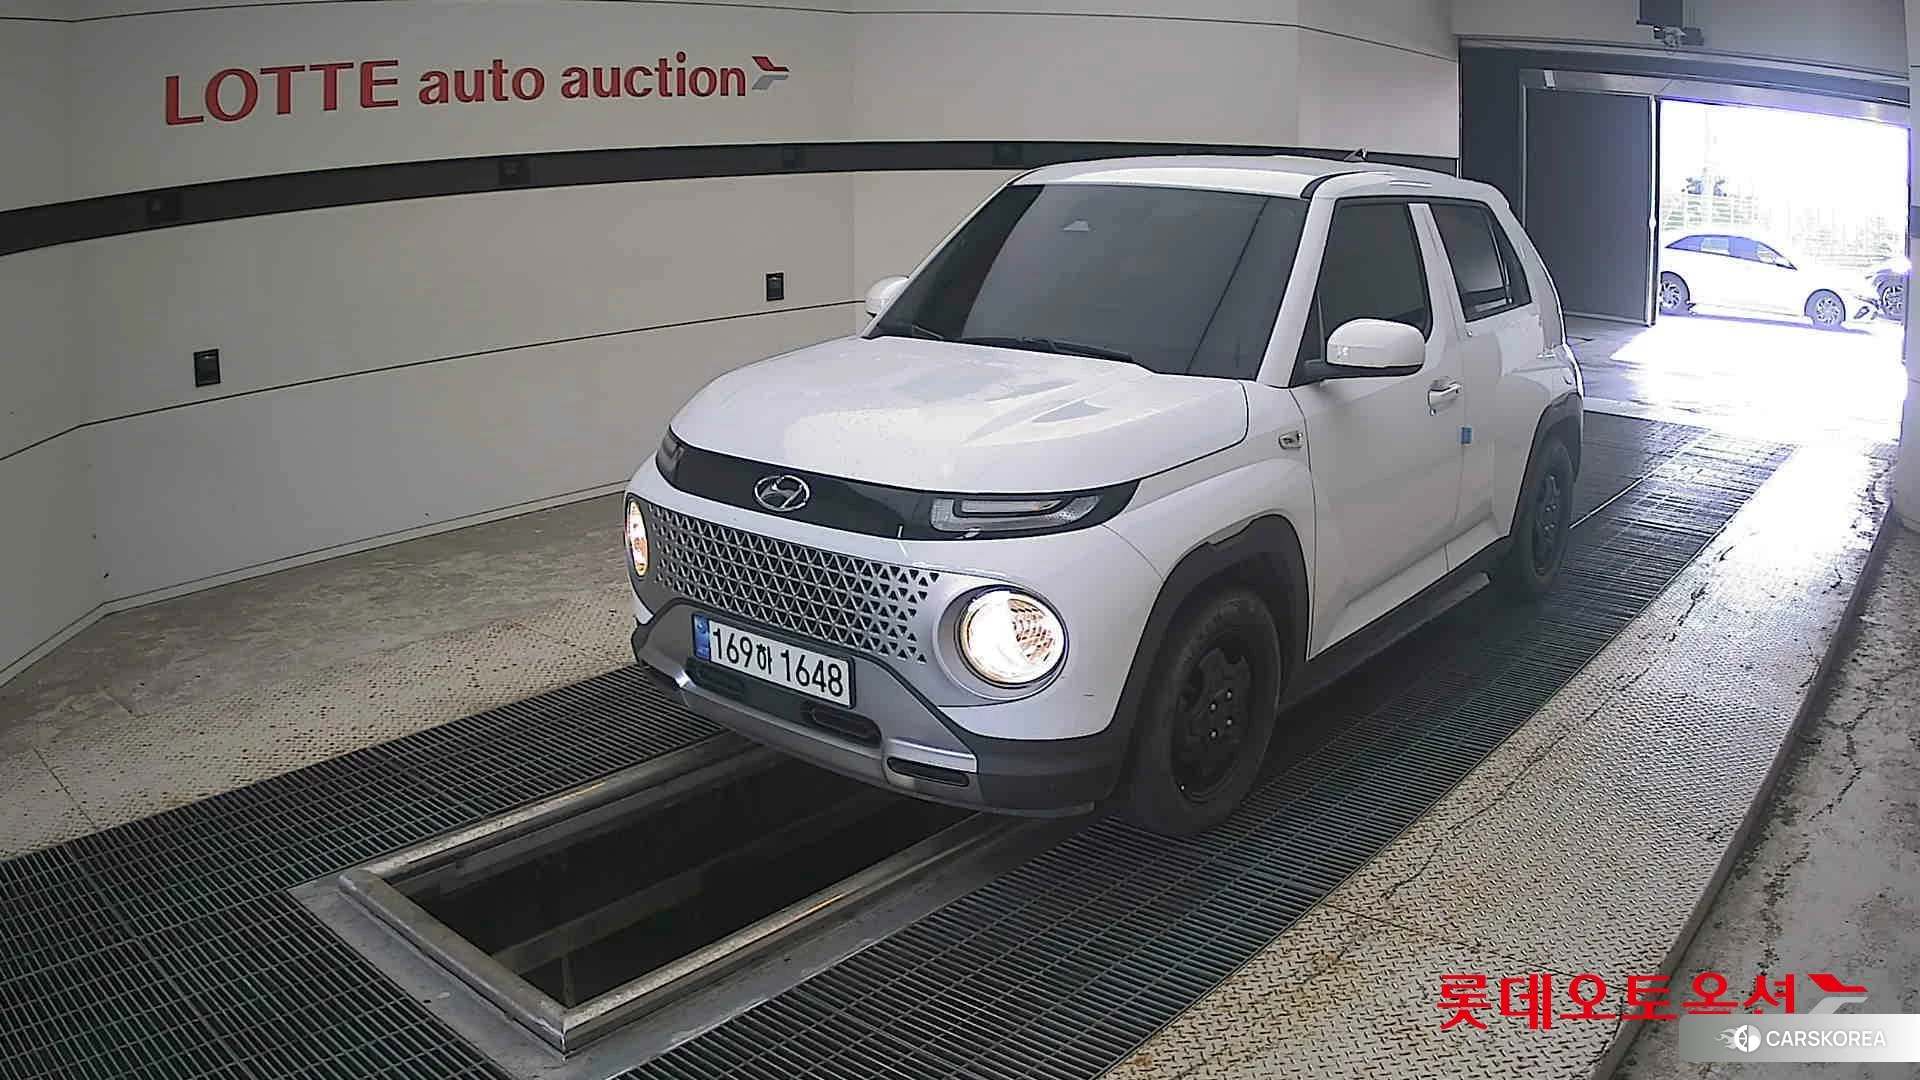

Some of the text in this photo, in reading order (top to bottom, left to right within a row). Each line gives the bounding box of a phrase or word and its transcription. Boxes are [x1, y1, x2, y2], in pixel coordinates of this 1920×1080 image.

[165, 51, 747, 126] LOTTE auto auction
[713, 628, 844, 697] 169하 1648
